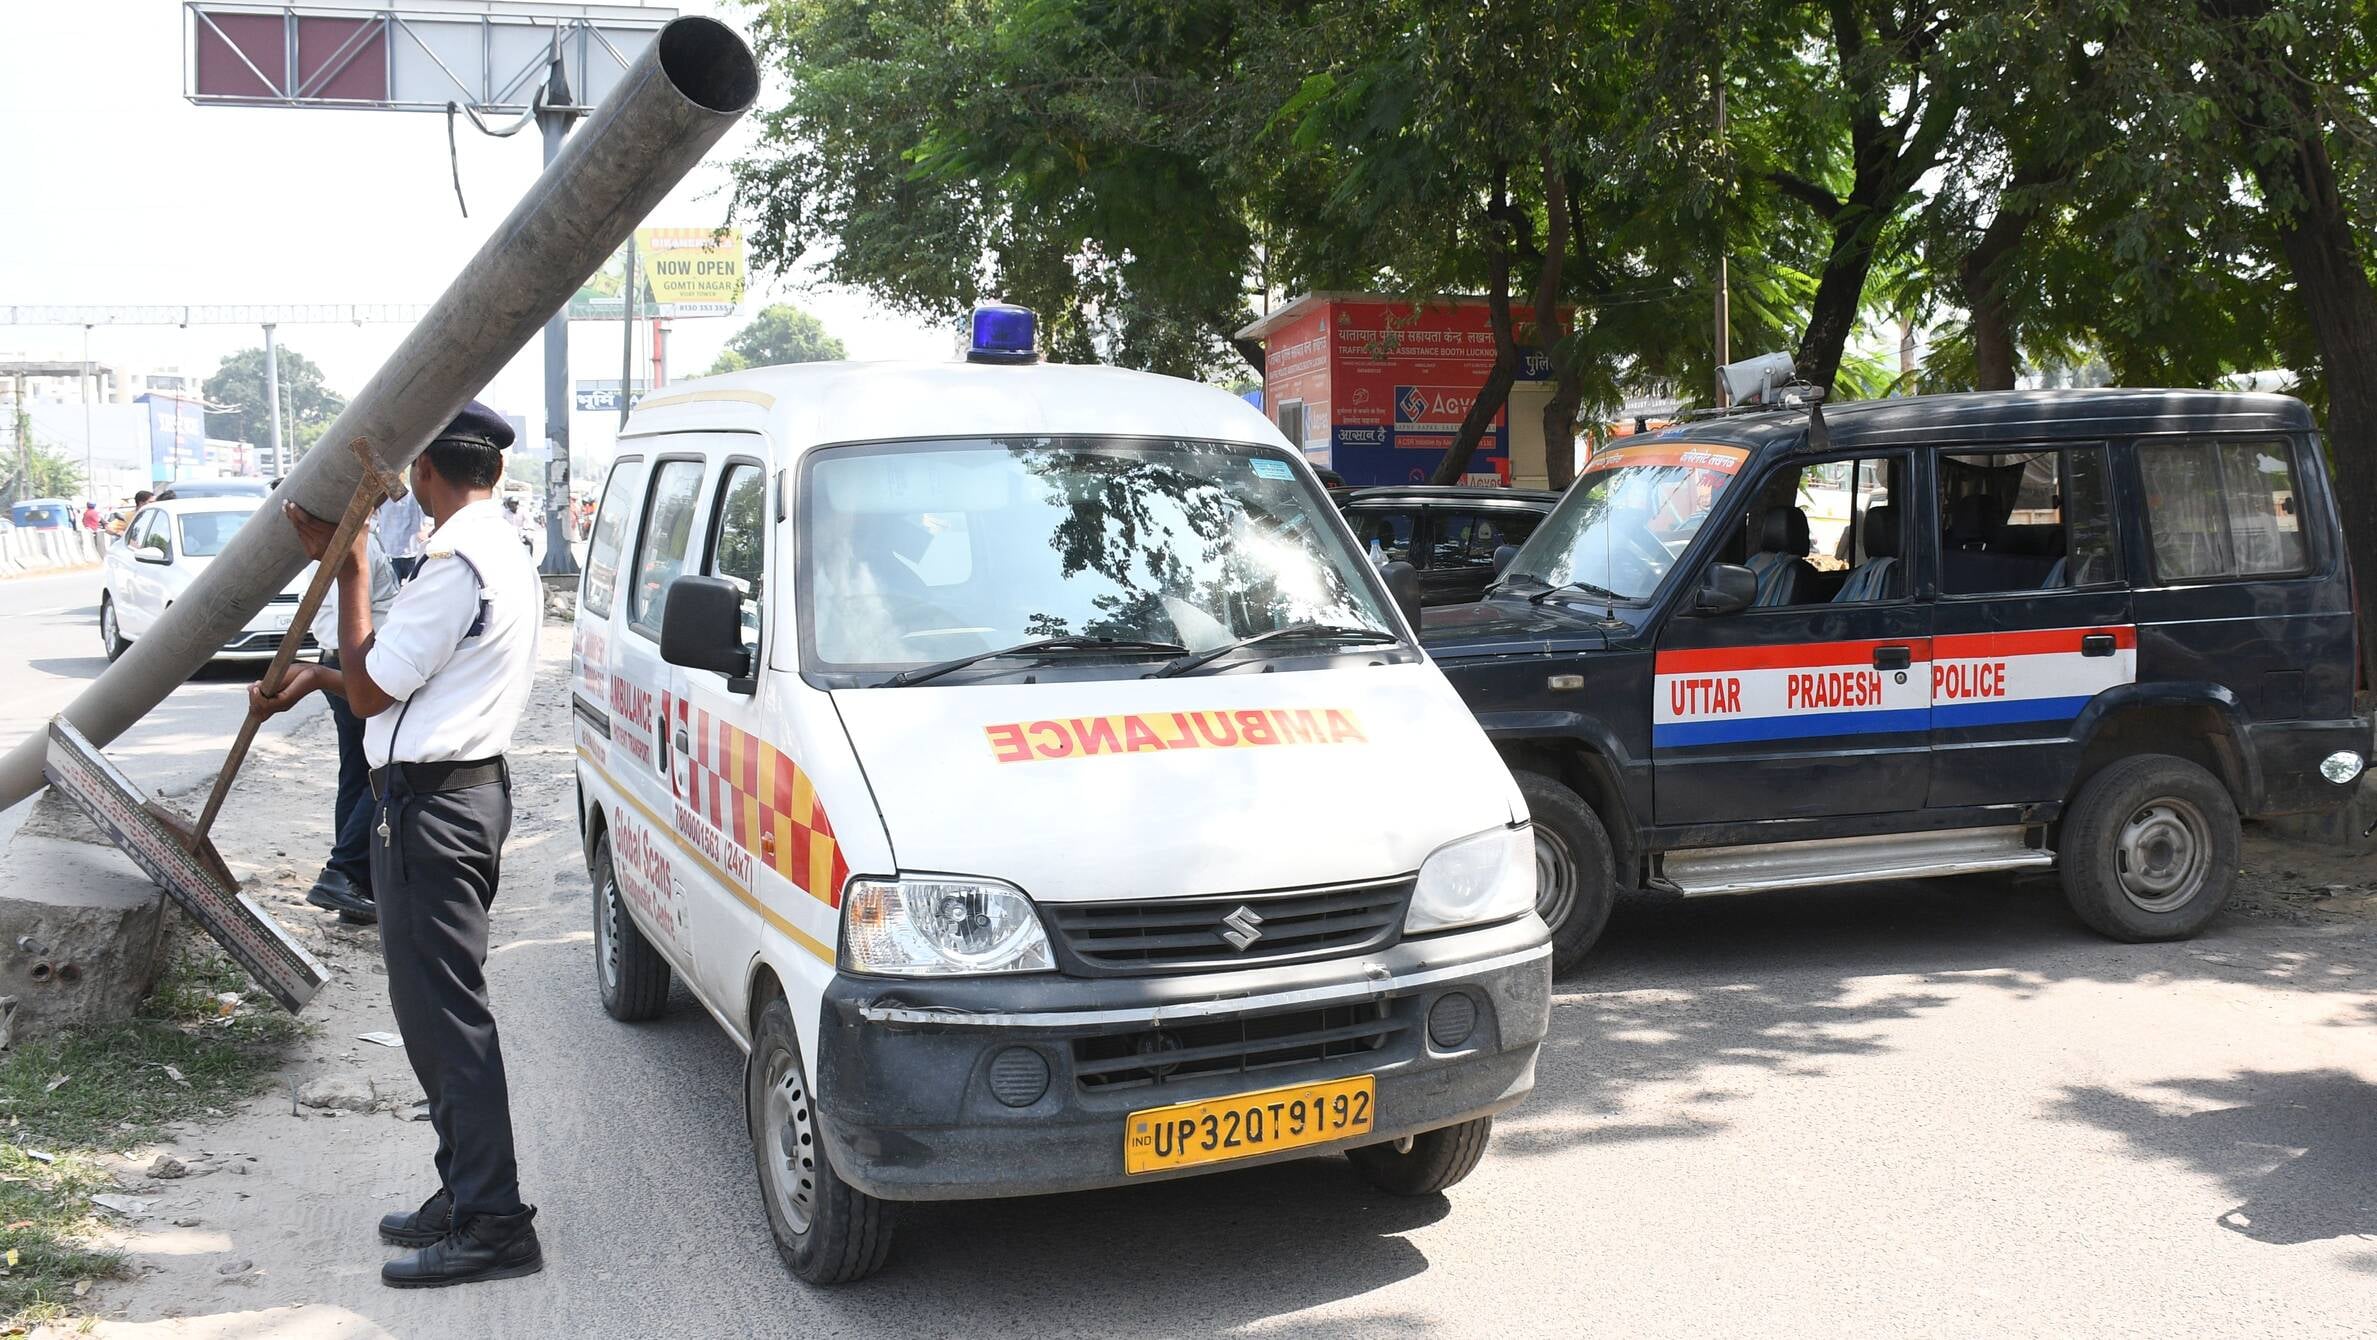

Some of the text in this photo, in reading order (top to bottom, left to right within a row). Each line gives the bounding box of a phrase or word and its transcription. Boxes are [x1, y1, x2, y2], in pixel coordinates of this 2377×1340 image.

[656, 261, 735, 275] NOW OPEN
[664, 281, 732, 290] GOMTI NAGAR
[1338, 329, 1376, 342] यातायात
[1408, 331, 1441, 343] सहायता
[1441, 348, 1464, 356] BOOTH
[1526, 352, 1554, 375] पुलि
[1338, 429, 1374, 441] आसान
[1377, 426, 1388, 442] है
[610, 673, 652, 734] AMBULANCE
[1671, 662, 2006, 716] UTTAR PRADESH POLICE
[132, 838, 174, 881] Available
[614, 805, 672, 901] Global Scans
[724, 839, 753, 894] (24x7)
[212, 909, 295, 990] ULTRASOUND
[1154, 1090, 1370, 1157] UP32QT9192
[1131, 1135, 1152, 1148] IND
